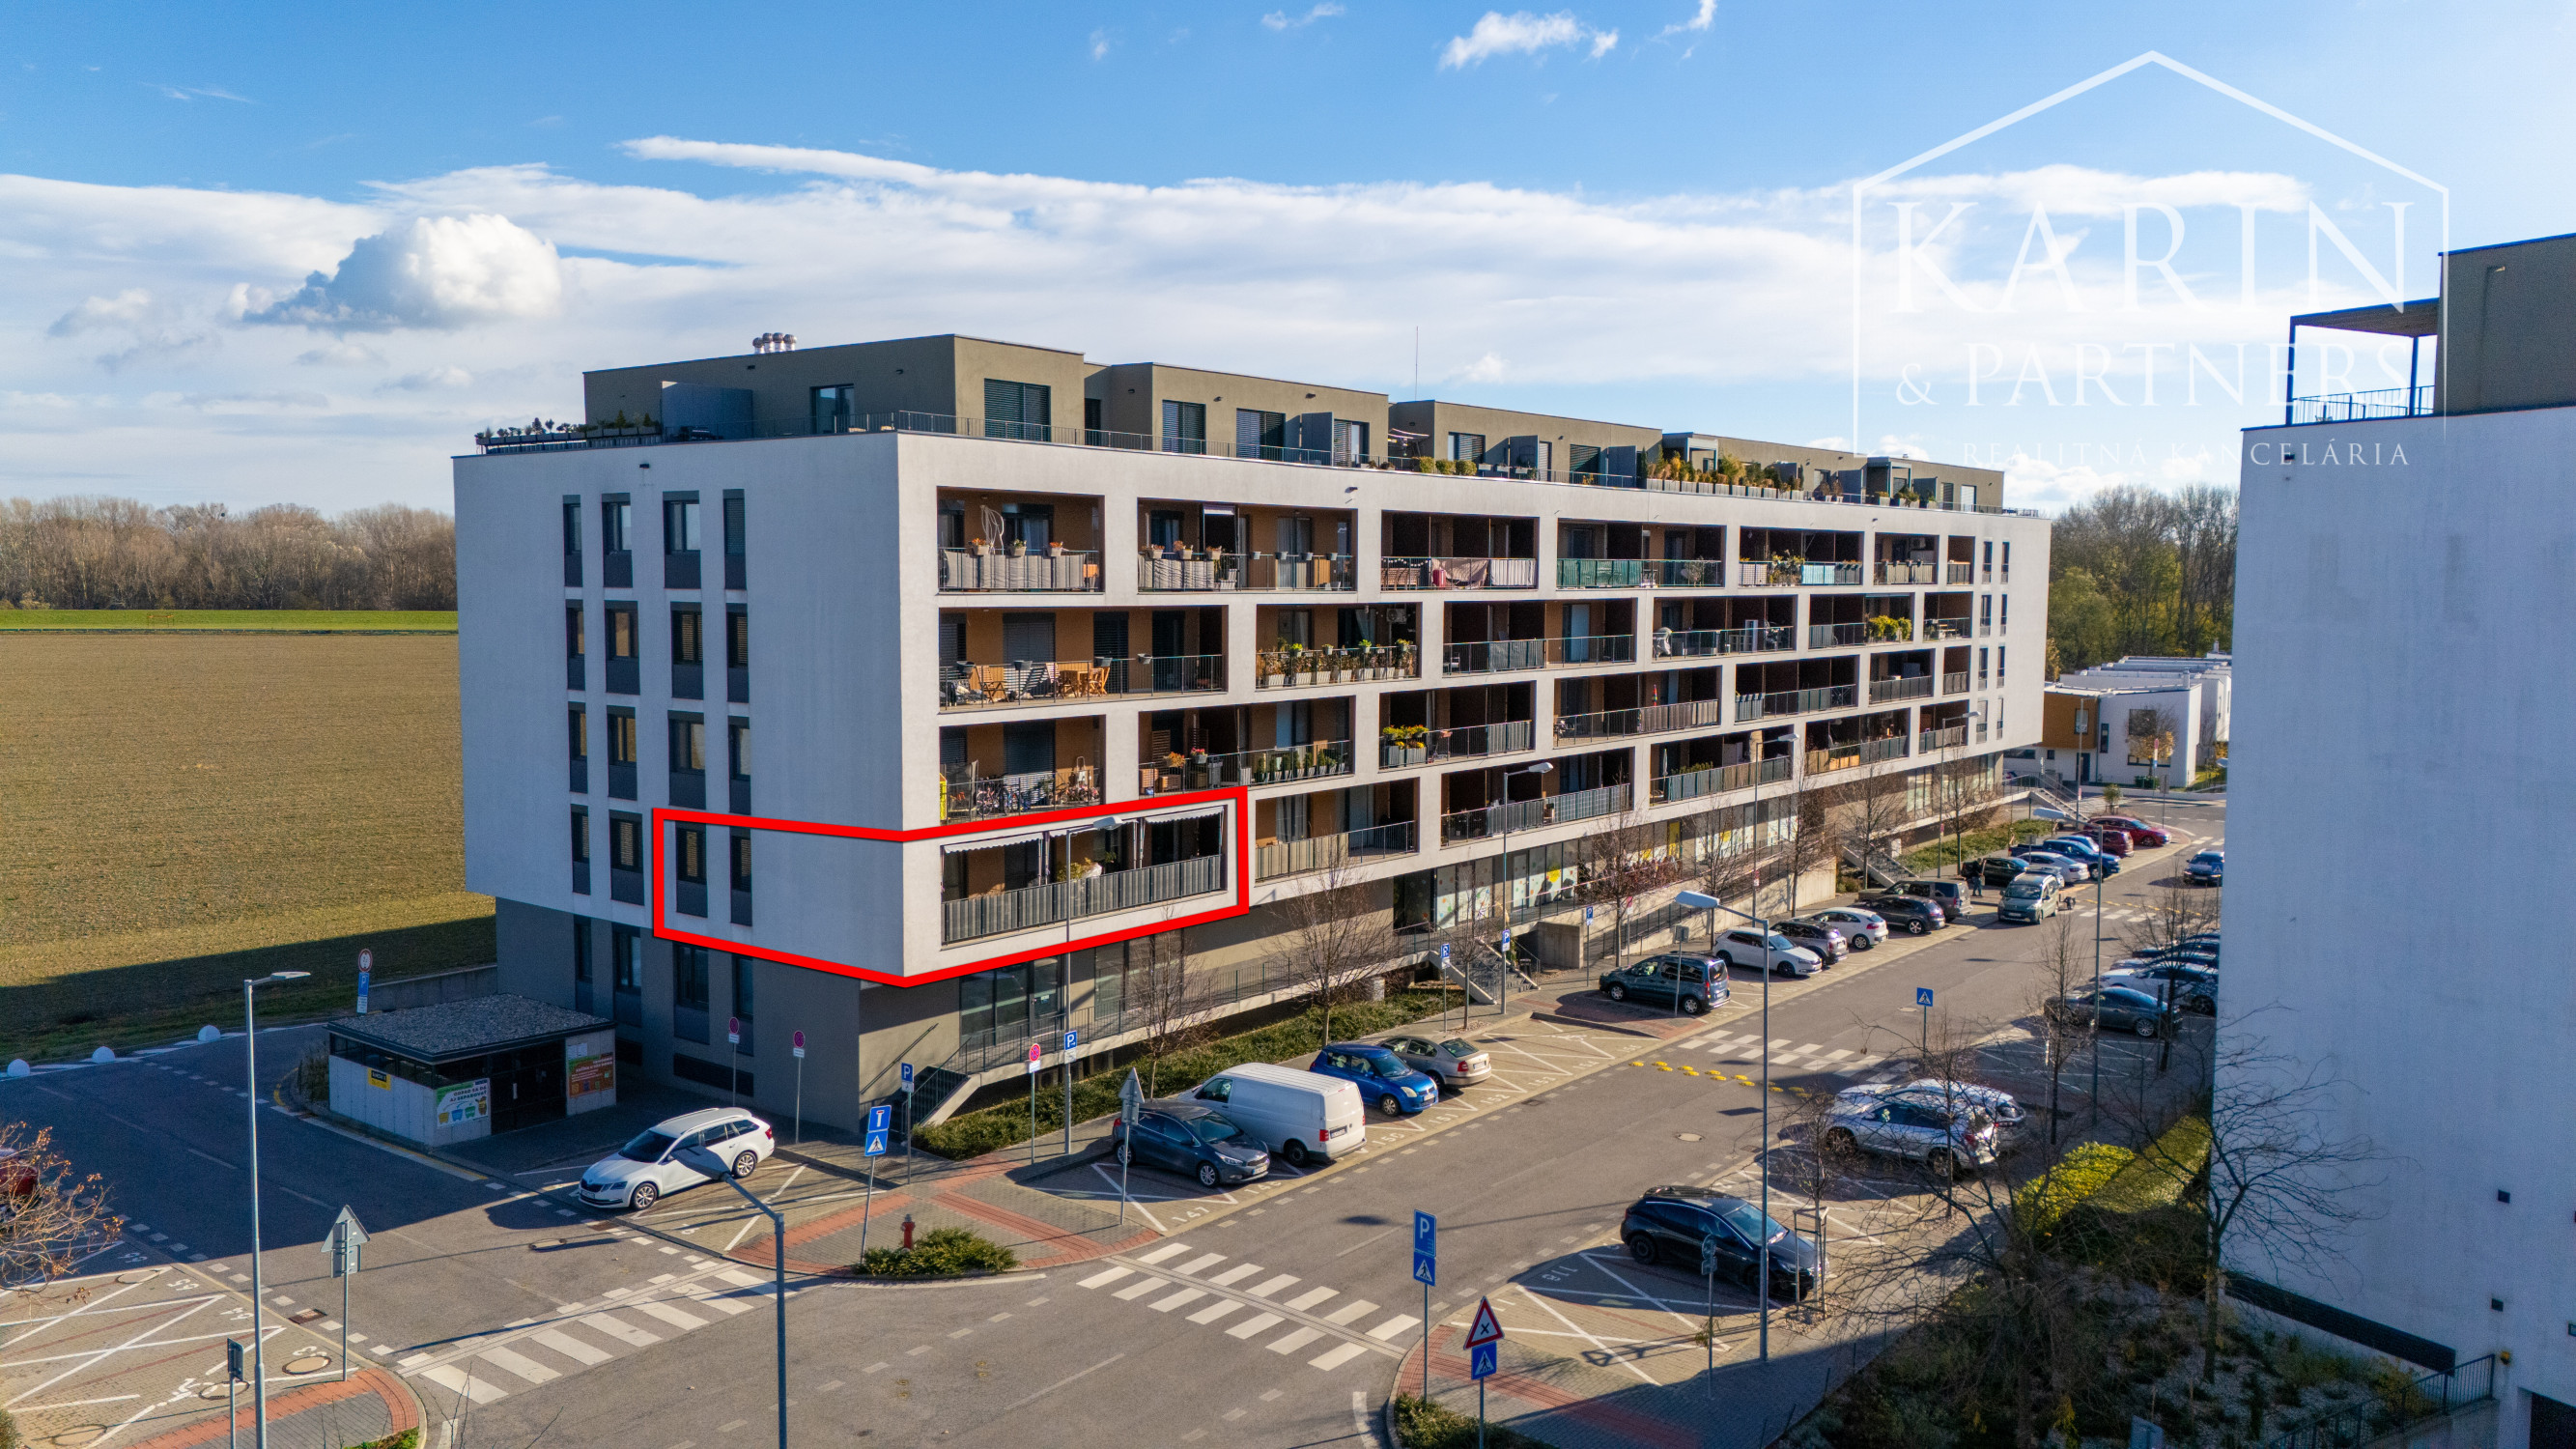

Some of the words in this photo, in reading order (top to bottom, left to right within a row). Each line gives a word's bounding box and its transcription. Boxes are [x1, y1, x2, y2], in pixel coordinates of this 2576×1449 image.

[1067, 1034, 1075, 1047] P
[903, 1065, 911, 1079] P
[1480, 1094, 1511, 1105] 152
[1172, 1206, 1210, 1223] 147
[1419, 1217, 1430, 1239] P
[1542, 1265, 1578, 1282] 118
